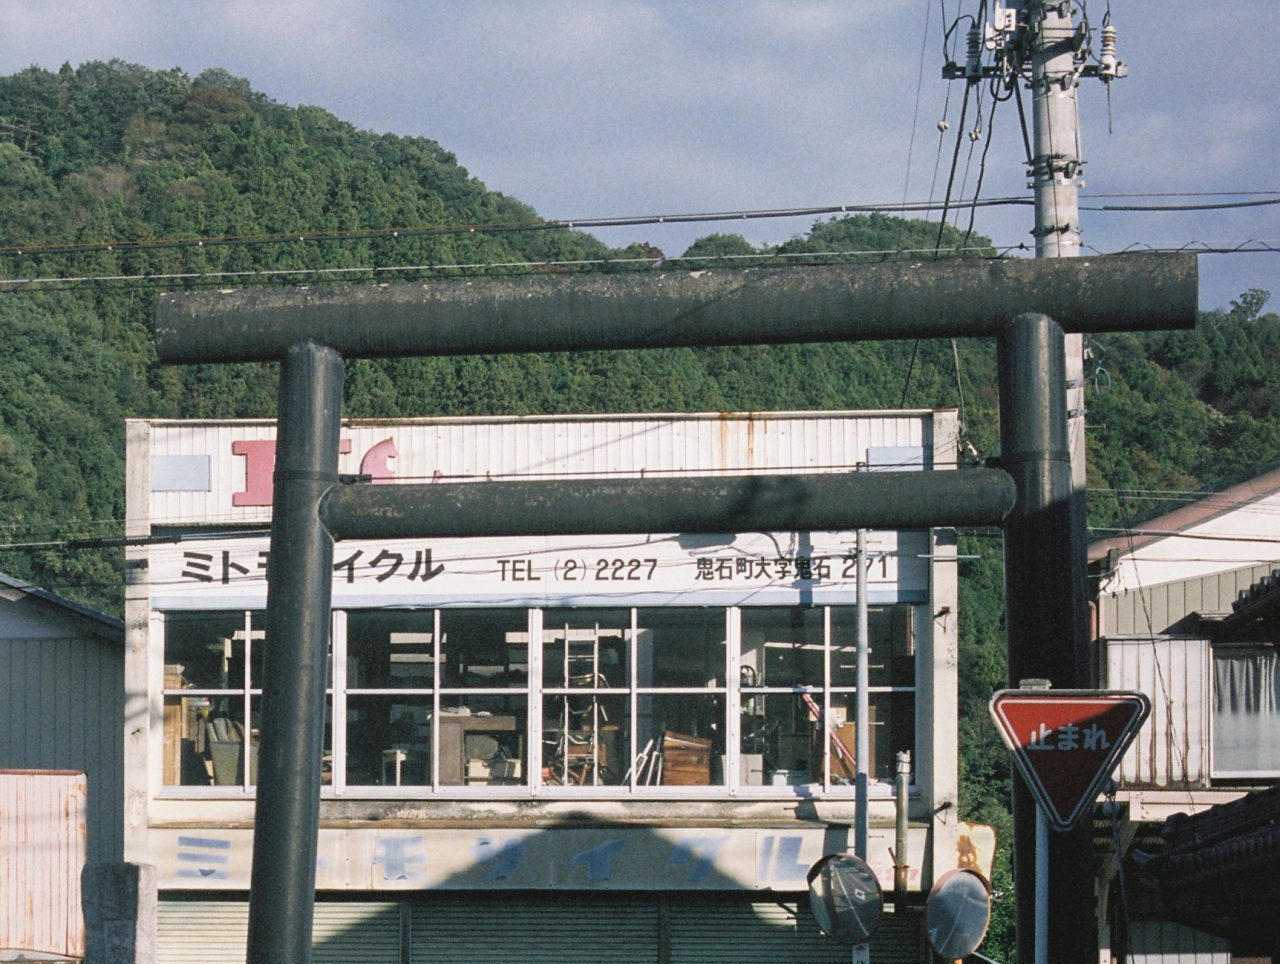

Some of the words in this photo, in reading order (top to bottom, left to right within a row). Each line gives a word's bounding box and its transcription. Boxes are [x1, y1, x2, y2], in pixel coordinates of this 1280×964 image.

[181, 548, 445, 584] ミトイクル
[497, 559, 541, 581] TEL
[1027, 722, 1110, 750] 止まれ
